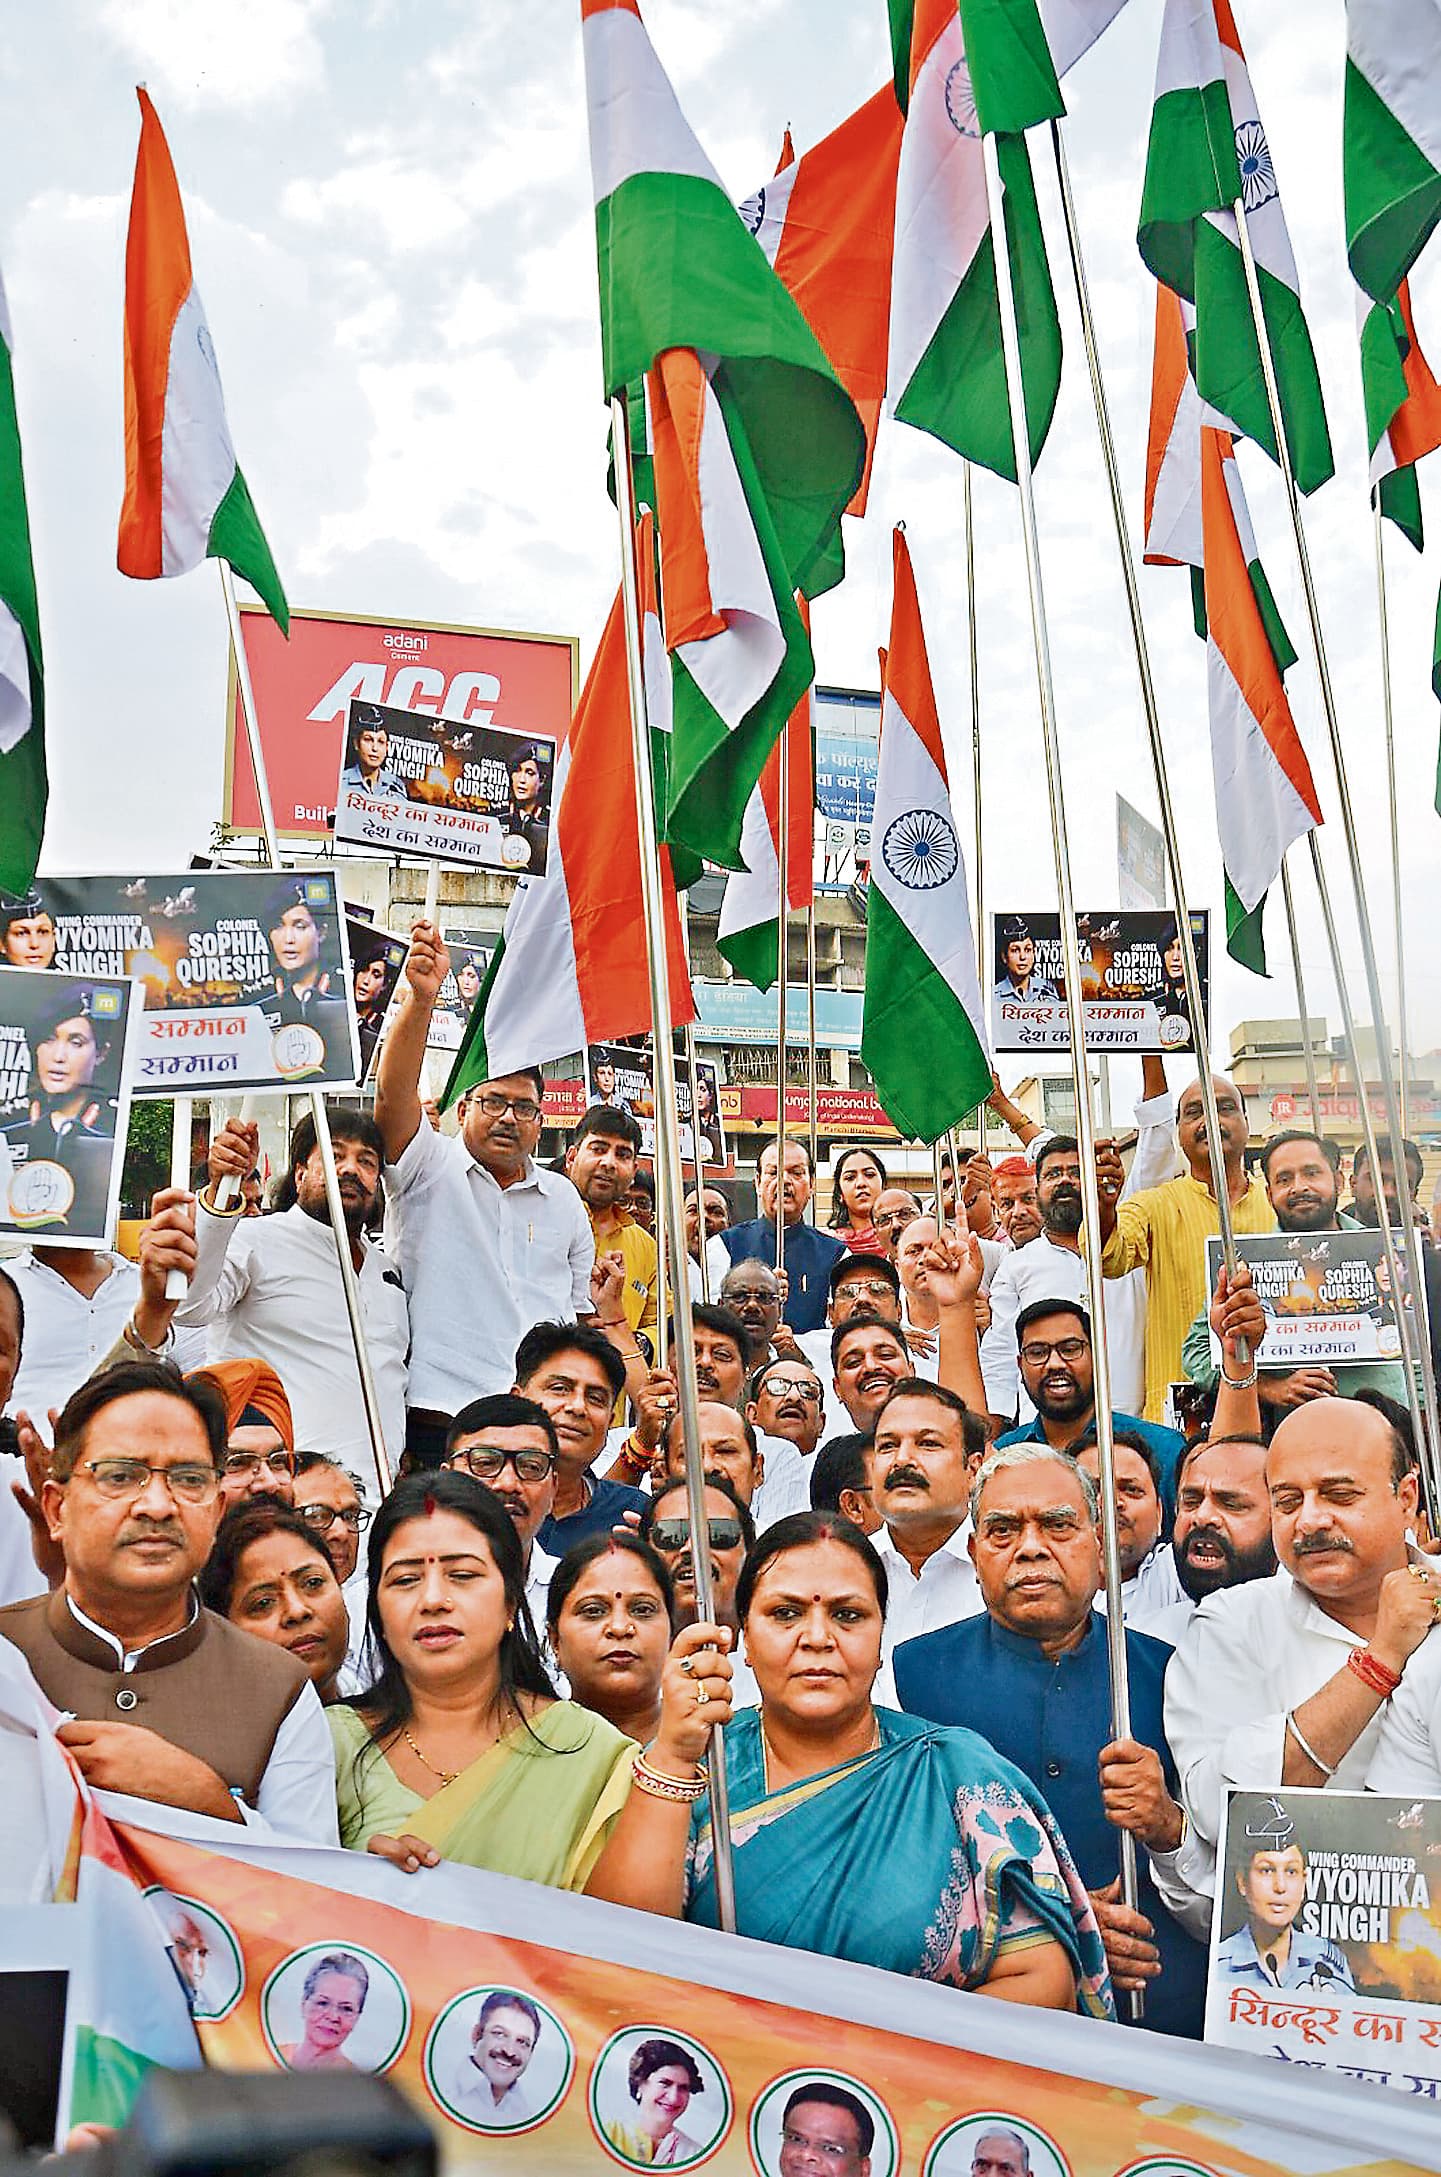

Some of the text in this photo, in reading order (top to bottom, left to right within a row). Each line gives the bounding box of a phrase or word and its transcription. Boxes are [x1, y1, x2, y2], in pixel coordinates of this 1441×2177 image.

[383, 633, 428, 650] adani
[386, 741, 445, 768] VYOMIKA
[384, 758, 426, 781] SINGH
[463, 763, 510, 787] SOPHIA
[453, 777, 510, 801] QURESHI
[346, 792, 490, 834] सिन्दूर का सम्मान
[362, 819, 482, 855] देश का सम्मान
[83, 915, 143, 927] COMMANDER
[216, 919, 260, 932] COLONEL
[55, 926, 154, 951] VYOMIKA
[189, 931, 269, 957] SOPHIA
[55, 951, 124, 976] SINGH
[1113, 951, 1163, 968] SOPHIA
[175, 956, 271, 986] QURESHI
[1034, 964, 1066, 980] SING
[1105, 968, 1163, 988] QURESHI
[1002, 1002, 1053, 1024] सिन्दूर
[1087, 1006, 1146, 1020] सम्मान
[150, 1016, 248, 1038] सम्मान
[1019, 1026, 1046, 1043] देश
[139, 1053, 240, 1075] सम्मान
[820, 1095, 868, 1110] national
[1324, 1267, 1374, 1286] SOPHIA
[1318, 1283, 1376, 1303] QURESHI
[1275, 1323, 1298, 1335] का
[1304, 1319, 1361, 1334] सम्मान
[1270, 1344, 1293, 1356] का
[1299, 1342, 1357, 1355] सम्मान
[1308, 1850, 1417, 1874] WING COMMANDER
[1303, 1866, 1431, 1910] VYOMIKA
[1301, 1904, 1390, 1944] SINGH
[1228, 1986, 1342, 2046] सिन्दूर
[1352, 2010, 1408, 2044] का
